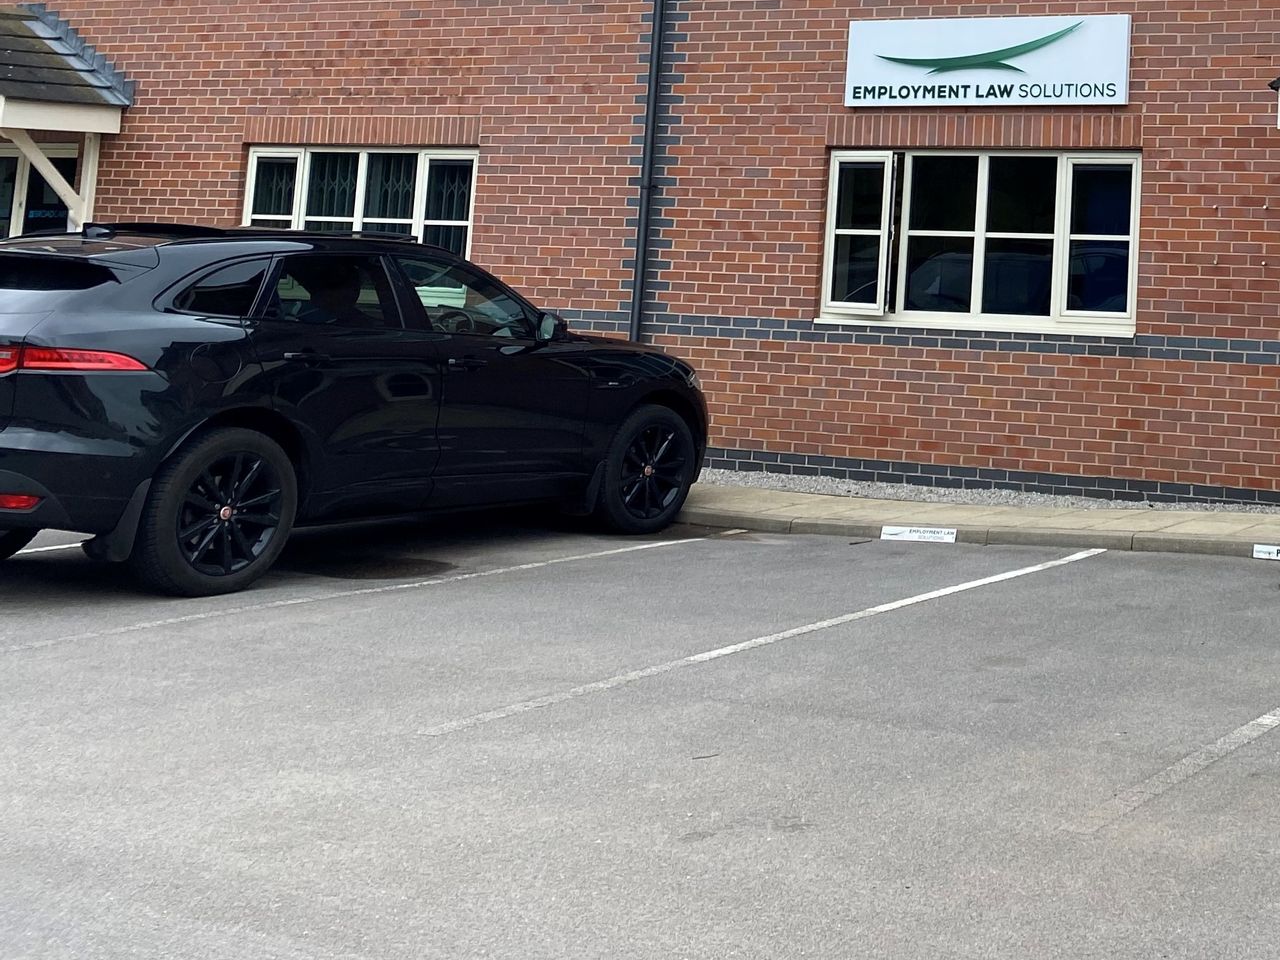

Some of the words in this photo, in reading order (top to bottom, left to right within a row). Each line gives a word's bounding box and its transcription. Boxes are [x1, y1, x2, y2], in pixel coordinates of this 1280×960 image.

[852, 84, 970, 100] EMPLOYMENT
[975, 84, 1015, 98] LAW
[1018, 83, 1117, 98] SOLUTIONS
